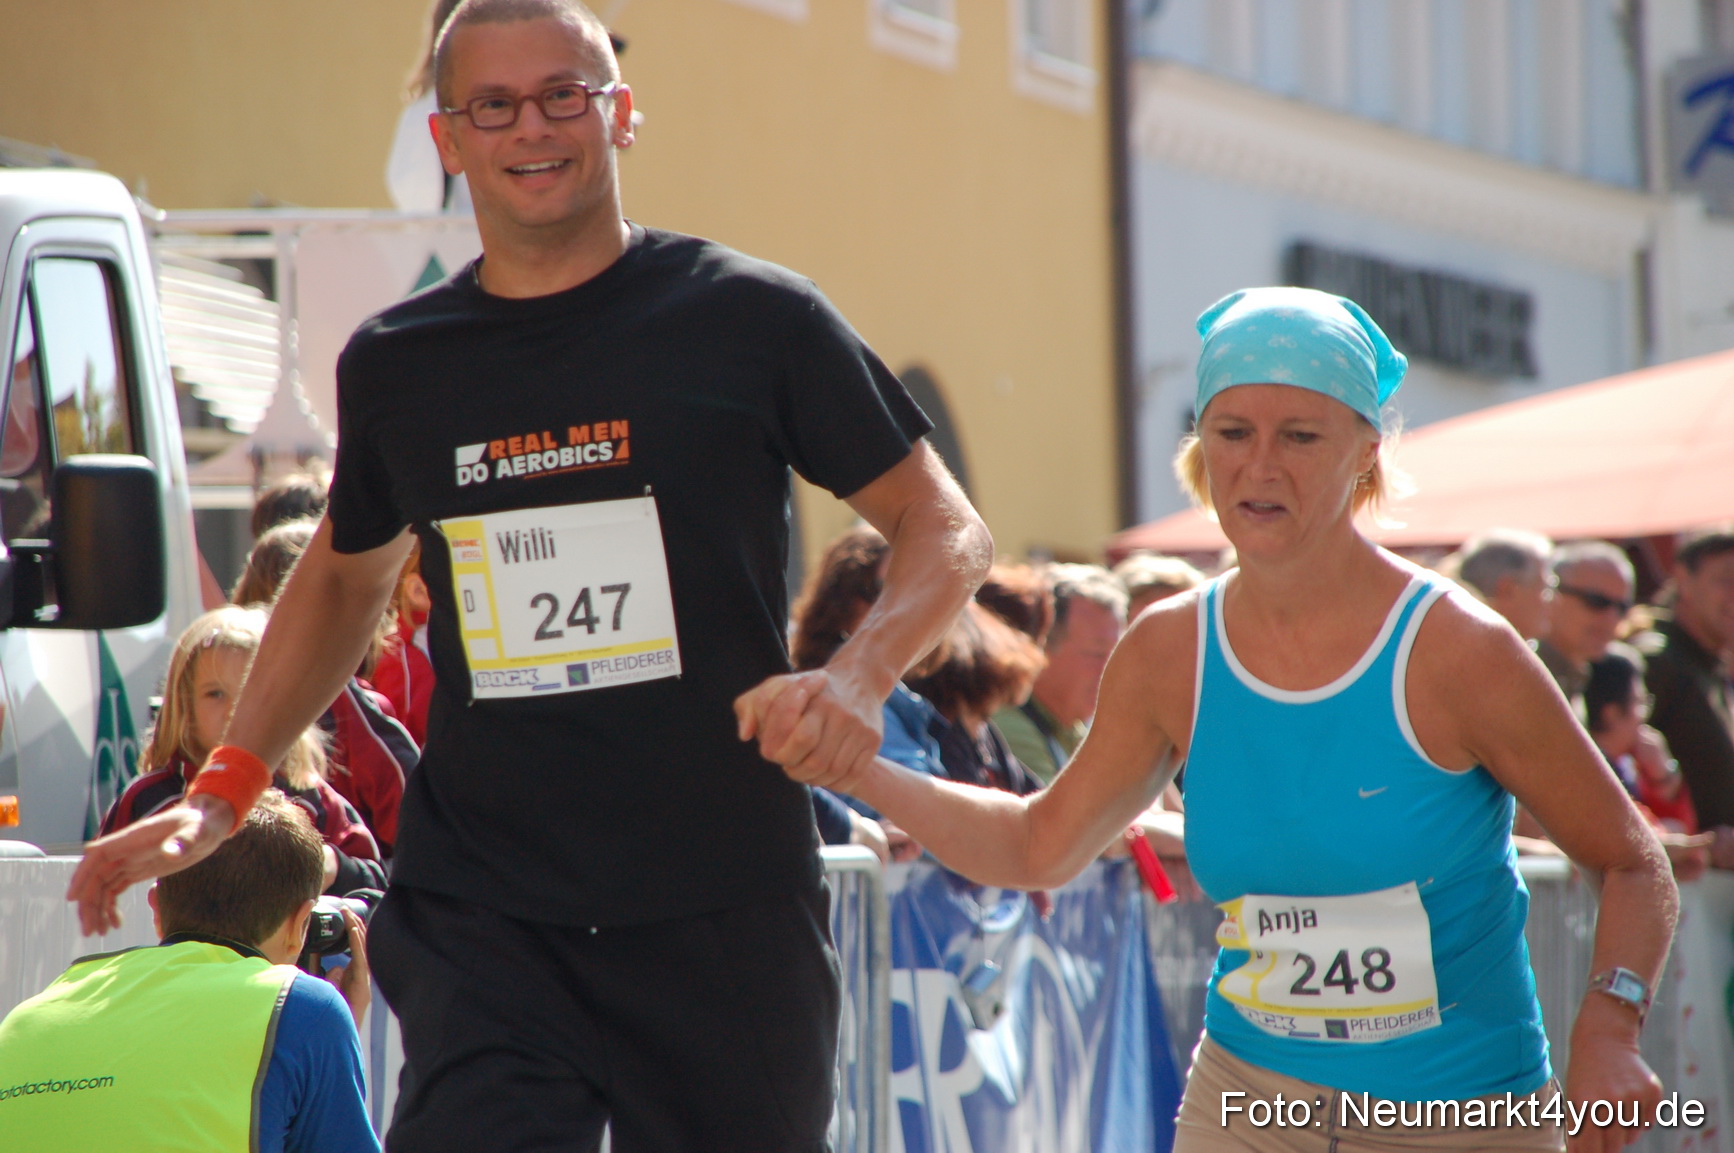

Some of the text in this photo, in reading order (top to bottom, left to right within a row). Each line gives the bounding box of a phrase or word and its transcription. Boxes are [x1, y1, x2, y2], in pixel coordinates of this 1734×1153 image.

[489, 420, 629, 459] REAL MEN
[456, 462, 489, 486] DO
[495, 441, 613, 479] AEROBICS
[496, 527, 557, 565] Willi
[463, 589, 476, 613] D
[530, 583, 632, 641] 247
[475, 668, 540, 688] BOCK
[591, 650, 675, 675] PFLEIDERER
[1258, 906, 1318, 937] Anja
[1290, 947, 1396, 995] 248
[1350, 1006, 1434, 1032] PFLEIDERER
